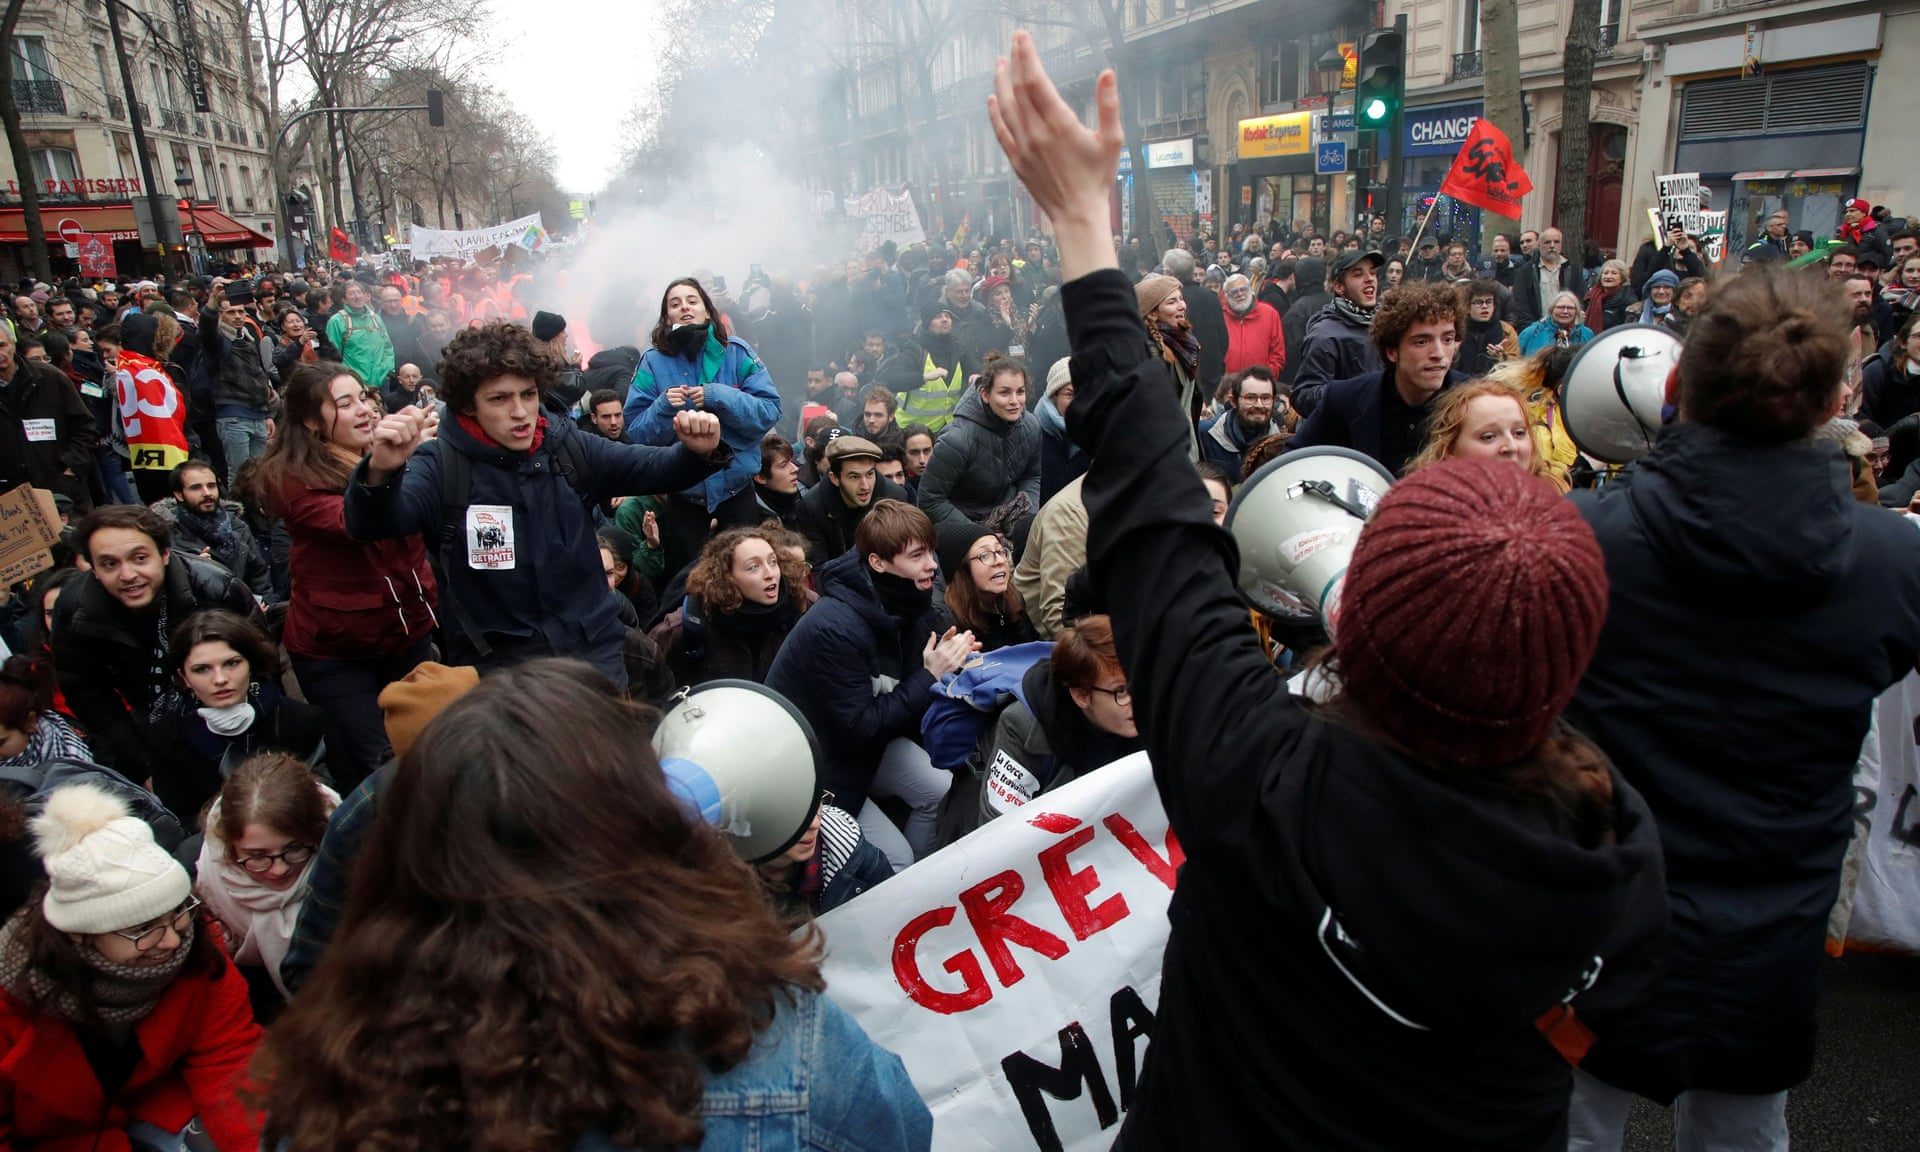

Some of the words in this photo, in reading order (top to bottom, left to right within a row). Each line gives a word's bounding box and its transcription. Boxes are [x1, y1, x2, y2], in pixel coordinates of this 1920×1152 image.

[44, 177, 142, 195] PARISIEN
[472, 552, 513, 563] RETRAITE
[997, 753, 1005, 765] La
[1004, 759, 1024, 780] force
[891, 811, 1187, 1015] GRÈV
